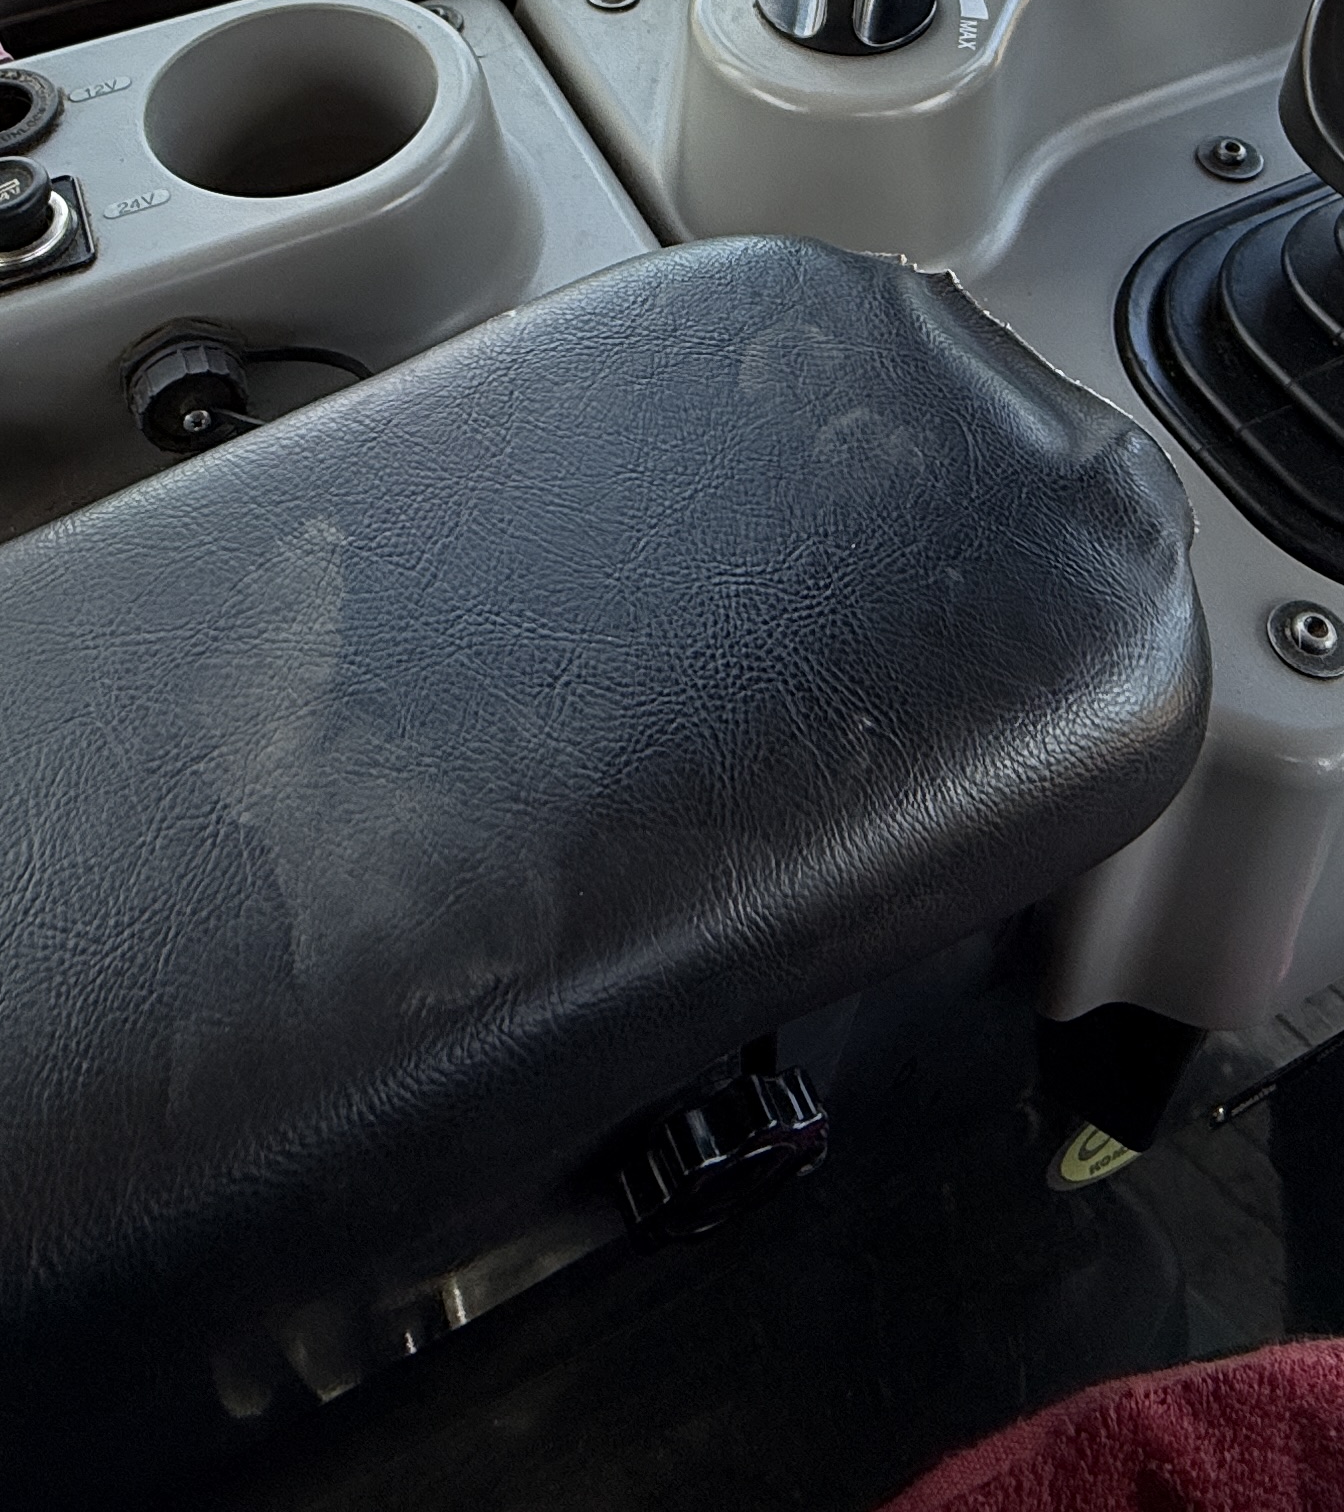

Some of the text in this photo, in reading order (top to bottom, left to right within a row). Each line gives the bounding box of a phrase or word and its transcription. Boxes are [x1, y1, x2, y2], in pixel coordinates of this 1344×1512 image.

[958, 19, 977, 50] MAX
[85, 79, 118, 98] 12V
[117, 192, 155, 215] 24V
